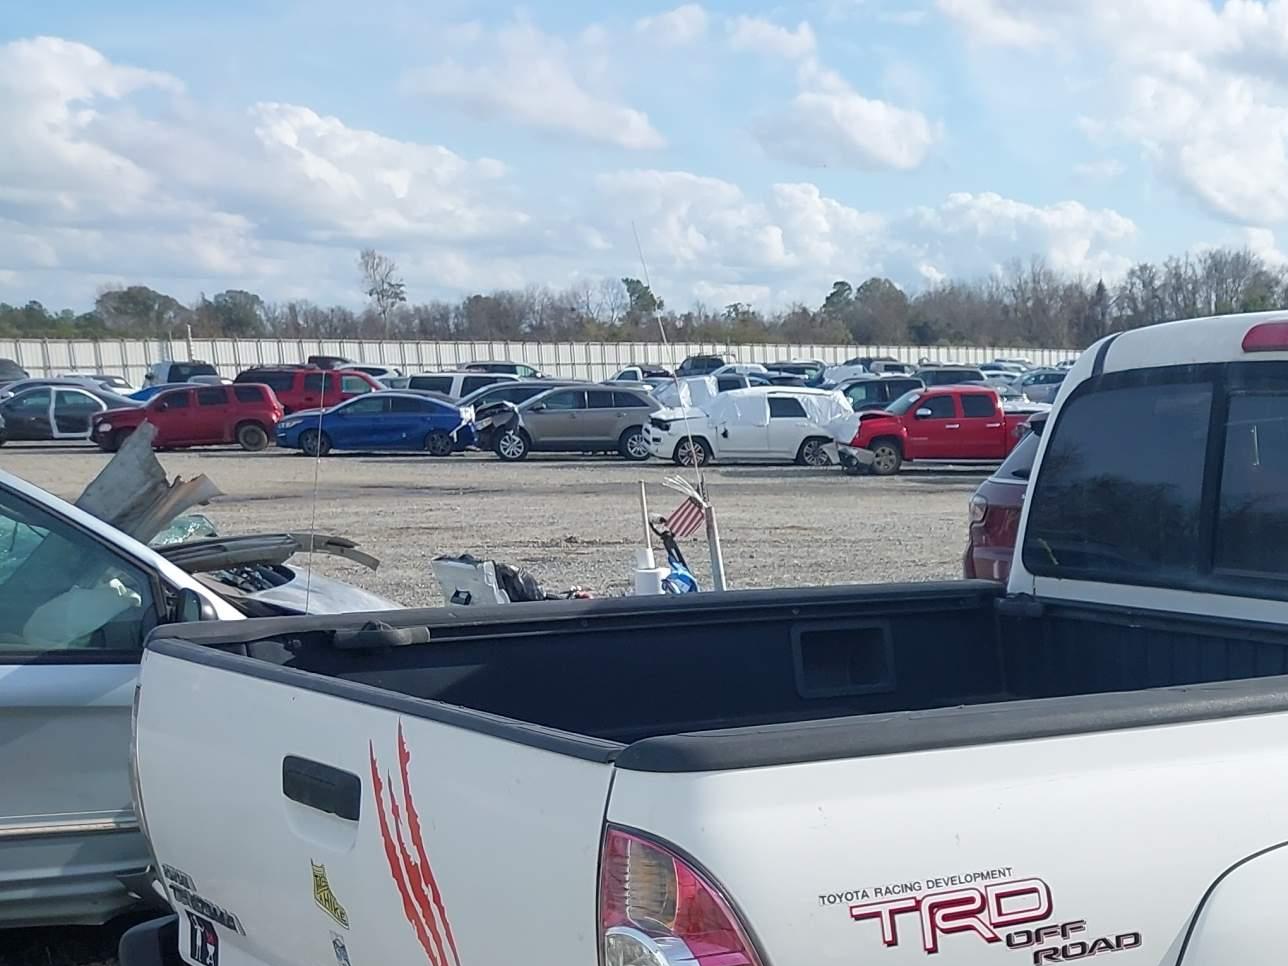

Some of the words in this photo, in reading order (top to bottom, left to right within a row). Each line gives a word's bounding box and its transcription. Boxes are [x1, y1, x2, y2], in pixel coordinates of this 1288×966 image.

[818, 888, 869, 905] TOYOTA
[874, 880, 922, 897] RACING
[926, 867, 1013, 890] DEVELOPMENT
[850, 877, 1053, 954] TRD
[1005, 919, 1087, 949] OFF
[1033, 931, 1142, 966] ROAD
